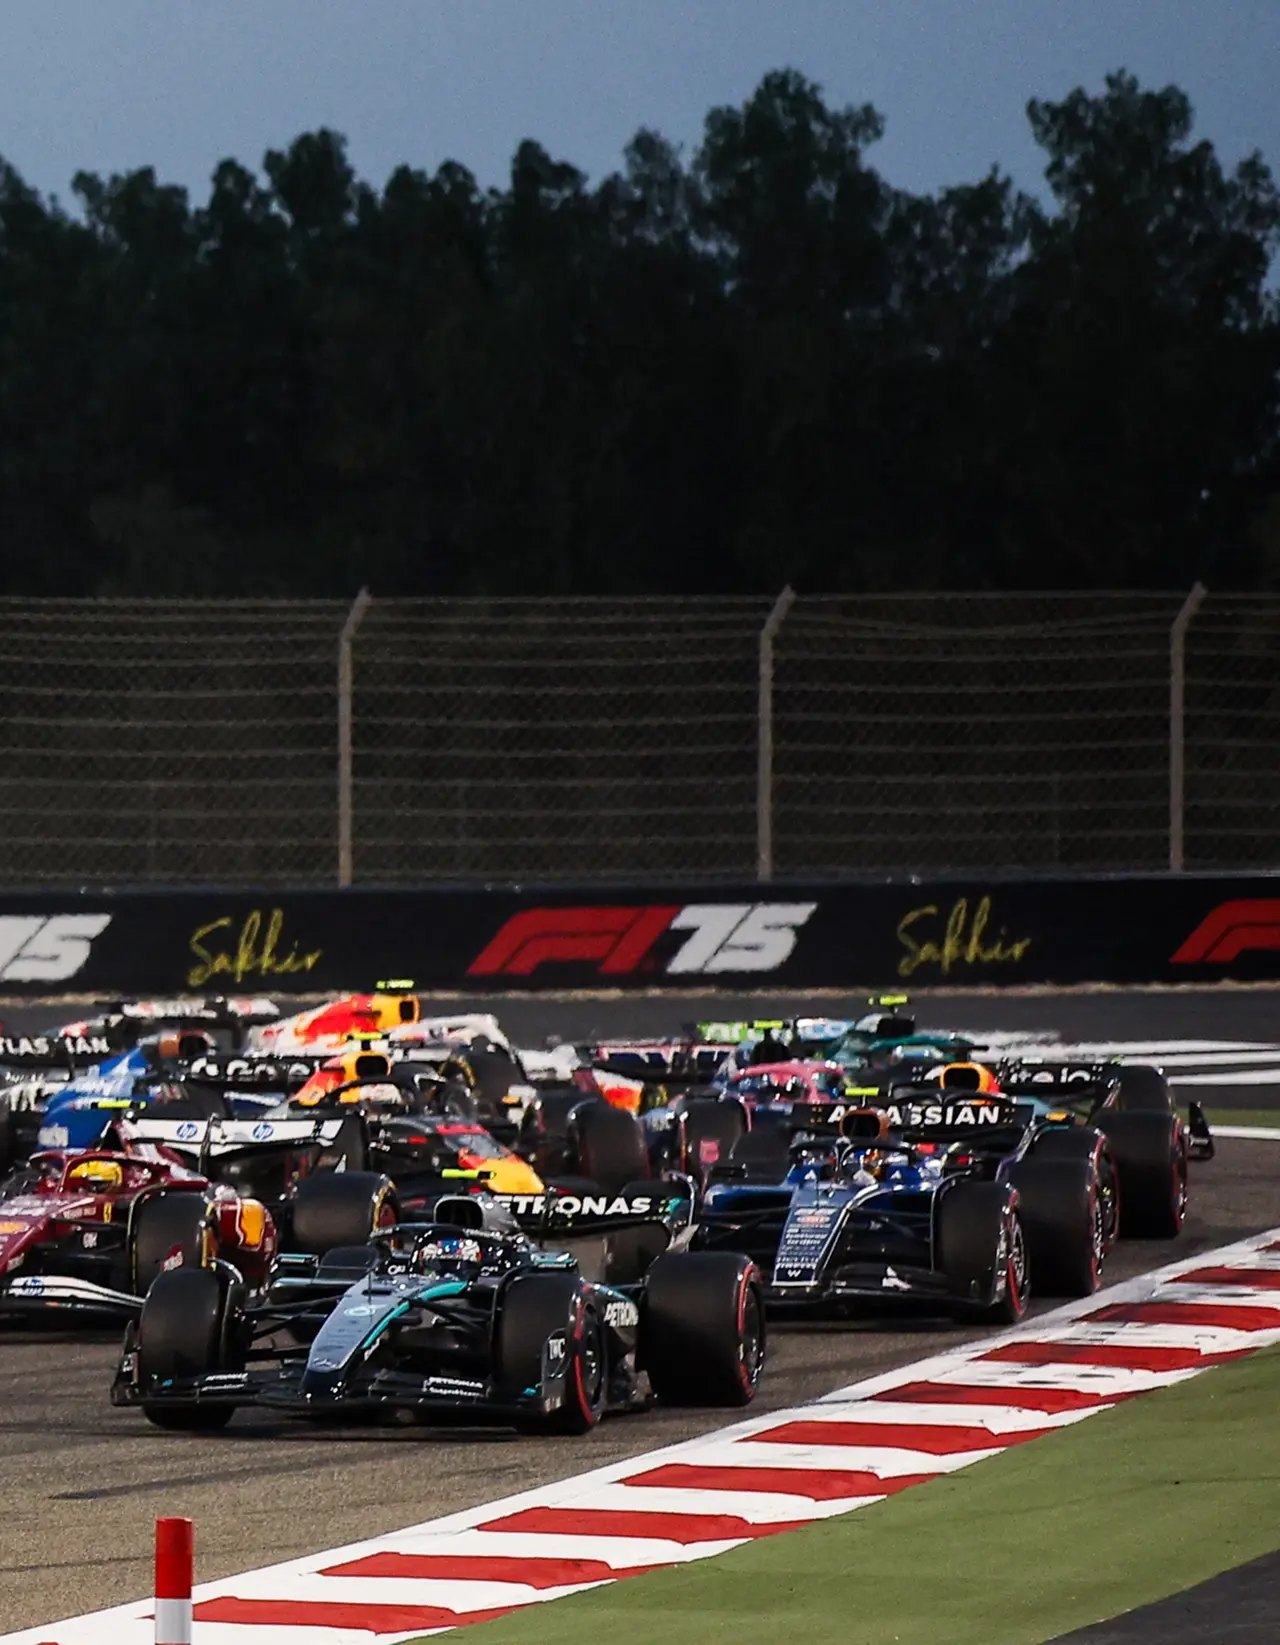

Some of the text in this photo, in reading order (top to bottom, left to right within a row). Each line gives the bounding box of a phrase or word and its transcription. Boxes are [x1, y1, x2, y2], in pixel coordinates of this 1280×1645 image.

[187, 909, 321, 986] Sakhir
[467, 903, 818, 974] F1 75
[896, 895, 1032, 976] Sakhir
[493, 1195, 651, 1216] ETRONAS
